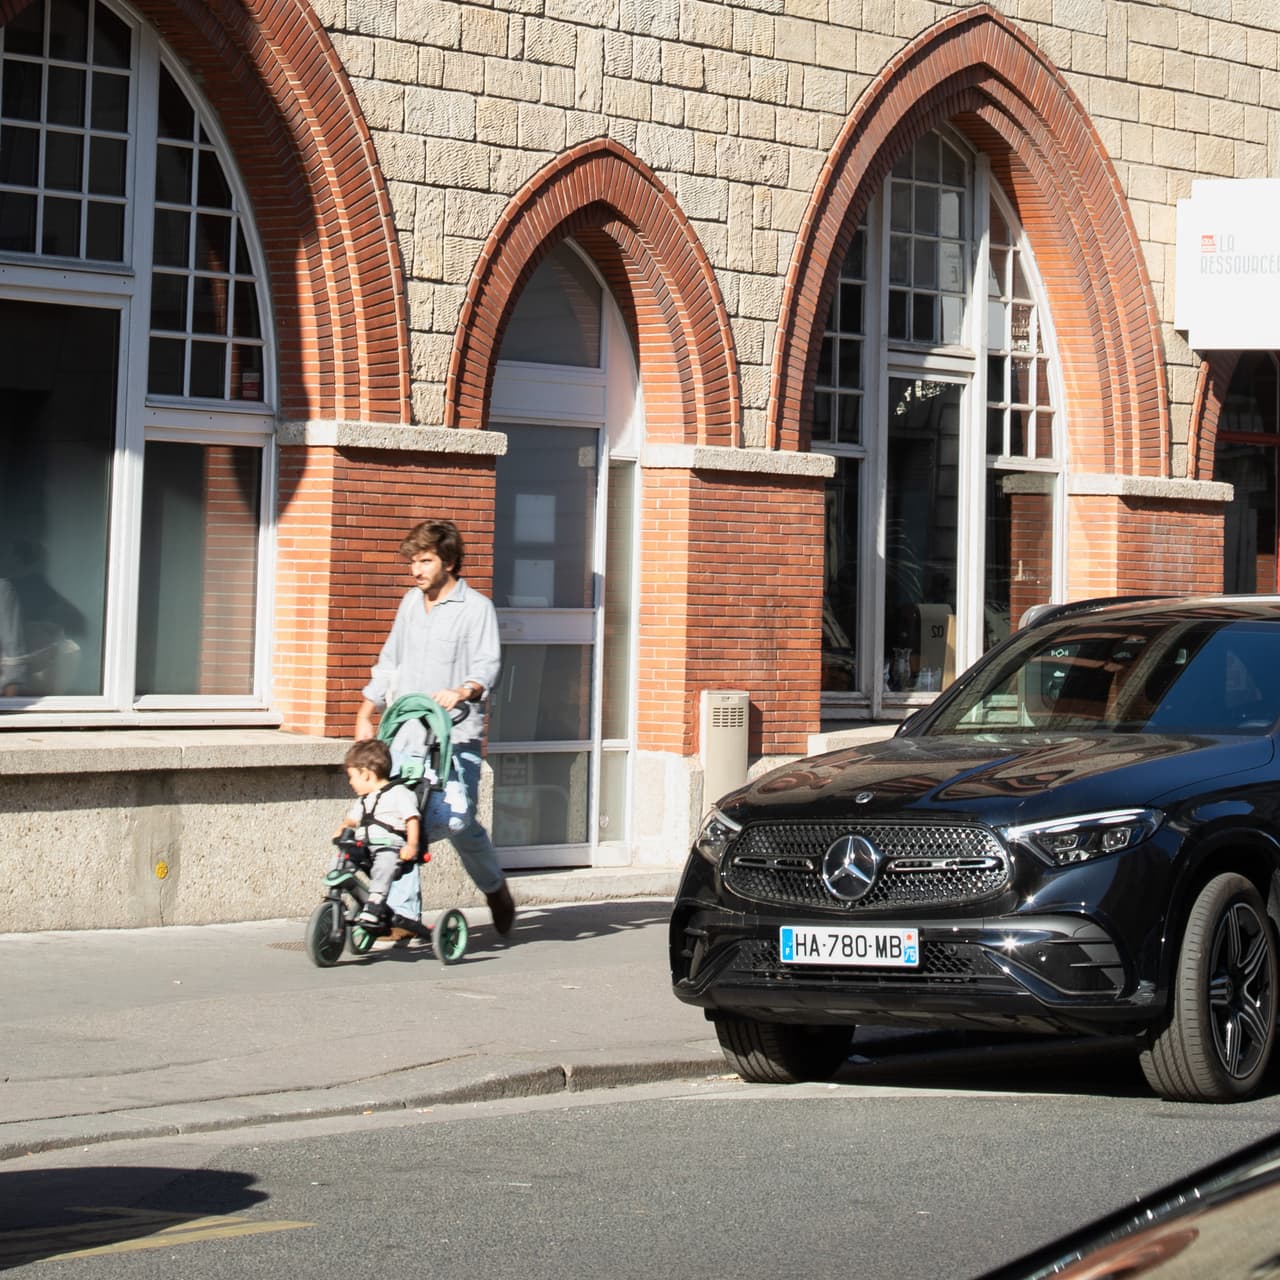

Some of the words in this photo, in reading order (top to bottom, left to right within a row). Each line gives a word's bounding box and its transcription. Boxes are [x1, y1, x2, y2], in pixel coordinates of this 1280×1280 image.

[1219, 233, 1235, 252] LA
[795, 933, 902, 959] HA-780-MB
[904, 948, 916, 960] 75
